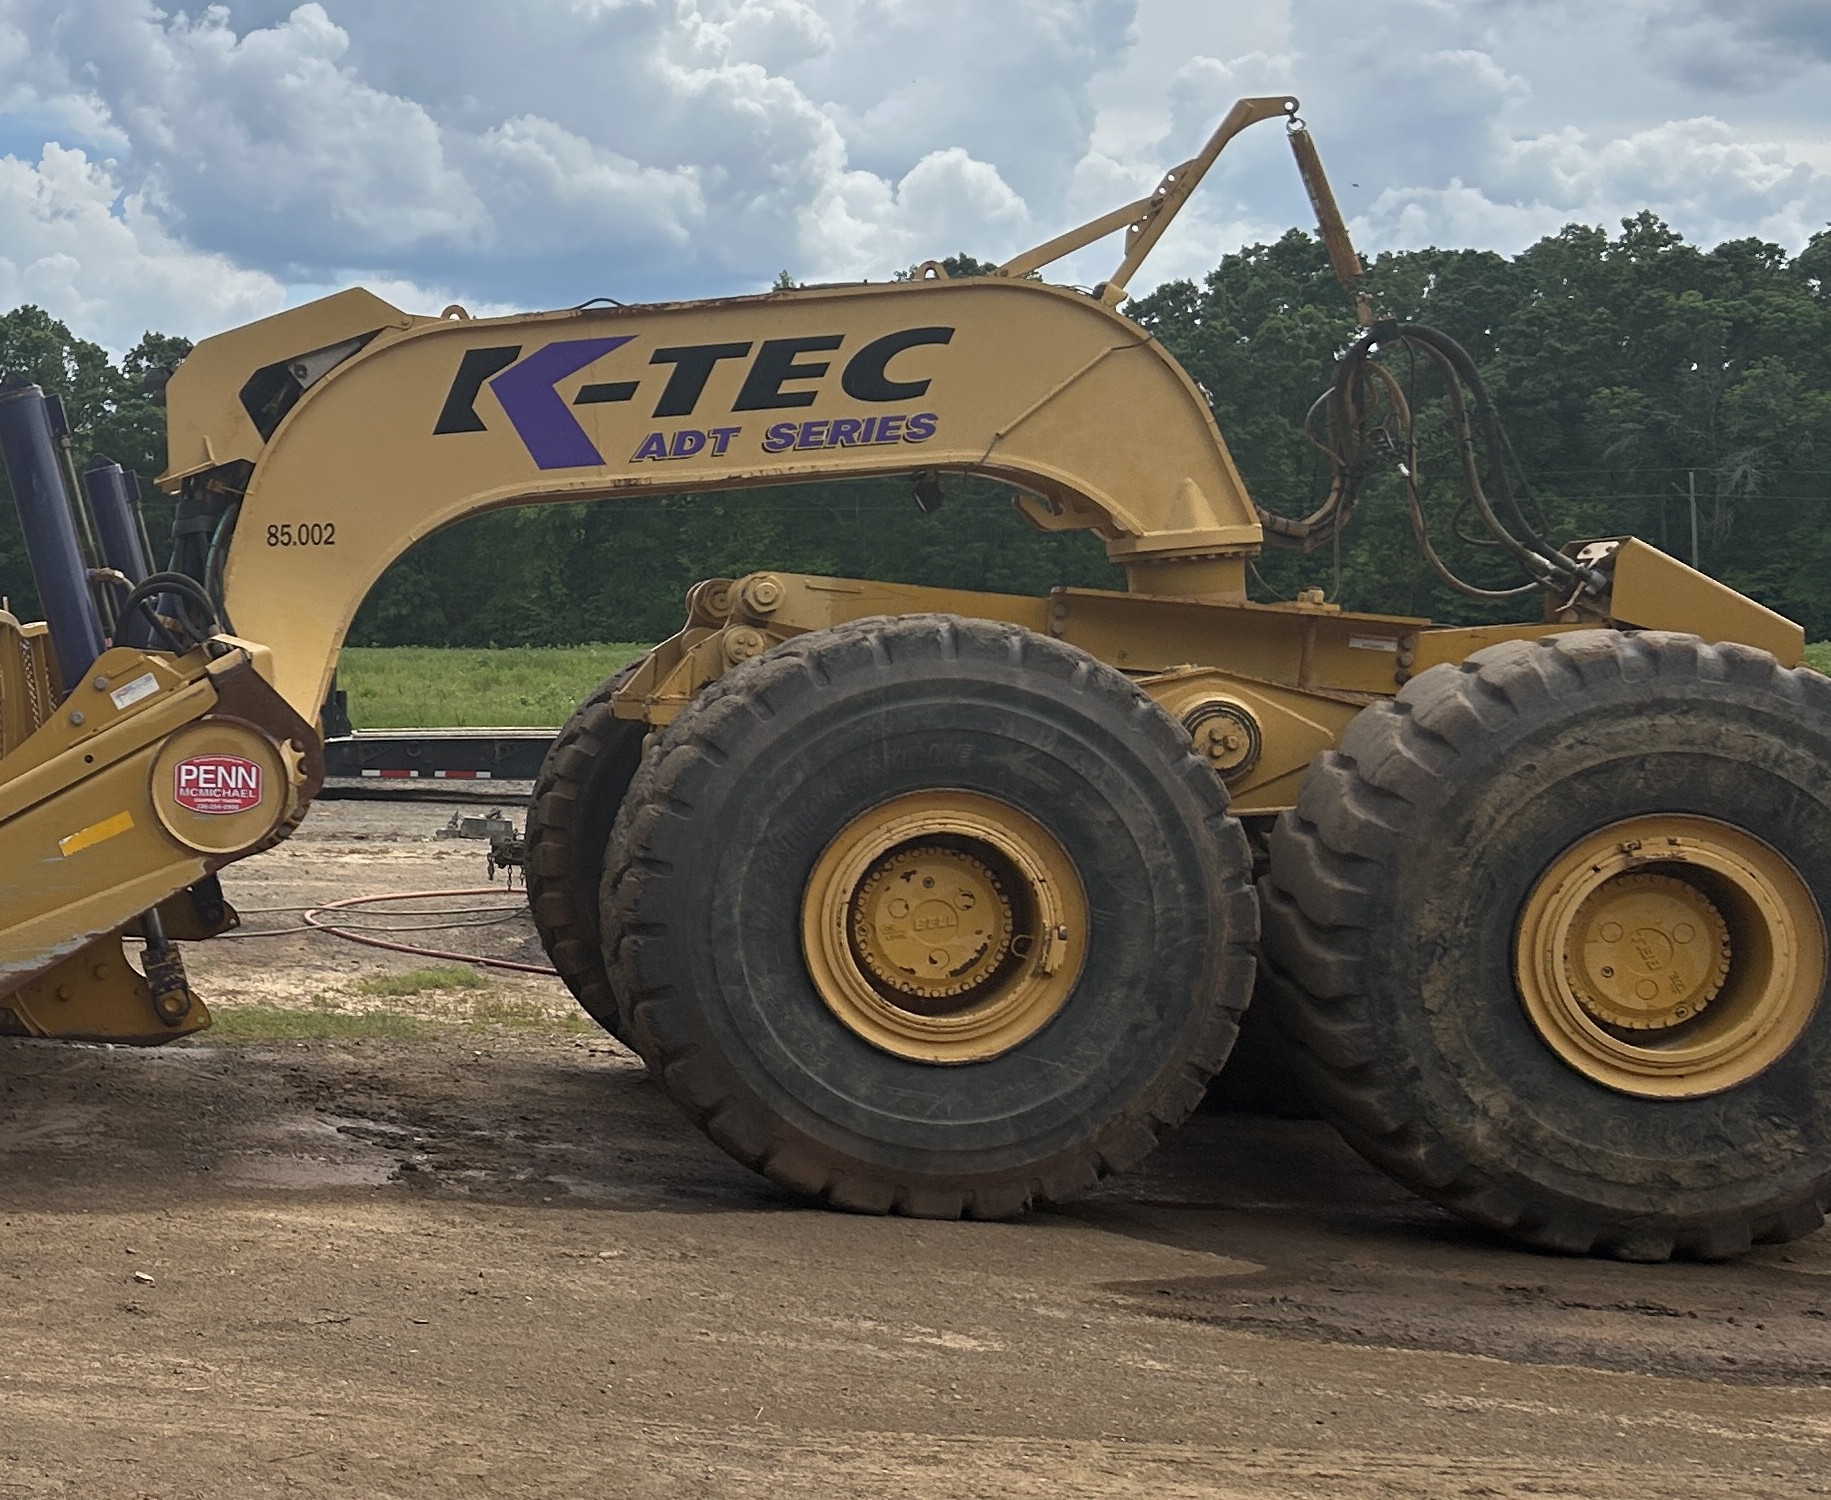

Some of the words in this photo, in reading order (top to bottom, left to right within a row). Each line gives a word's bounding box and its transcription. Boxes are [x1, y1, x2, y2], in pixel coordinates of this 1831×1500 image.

[432, 326, 955, 470] K-TEC
[630, 426, 741, 463] ADT
[762, 412, 939, 454] SERIES
[267, 523, 335, 546] 85.002
[180, 765, 257, 788] PENN
[913, 916, 957, 932] BELL
